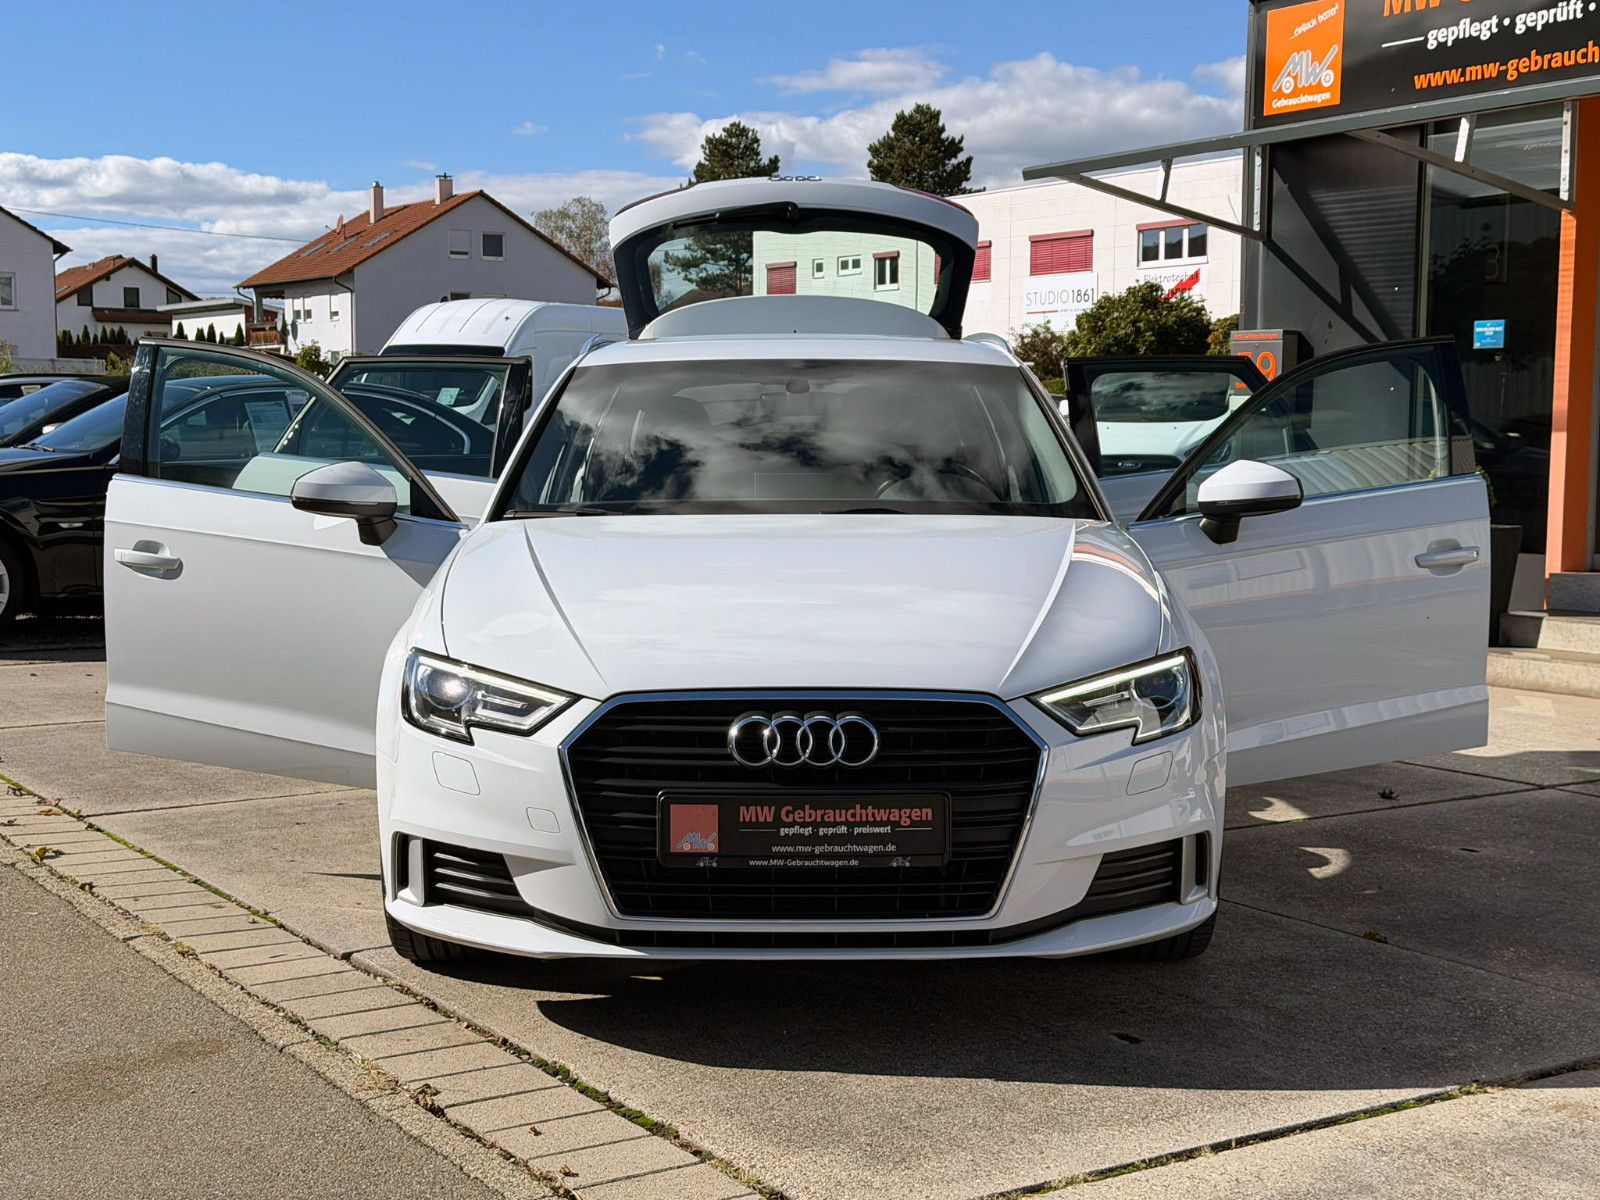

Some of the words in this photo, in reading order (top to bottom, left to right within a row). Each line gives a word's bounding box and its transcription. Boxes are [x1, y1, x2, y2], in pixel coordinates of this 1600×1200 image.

[1427, 15, 1499, 50] gepflegt
[1514, 1, 1584, 35] geprüft
[739, 805, 775, 823] MW
[780, 804, 933, 826] Gebrauchtwagen
[779, 826, 813, 837] gepflegt
[818, 825, 848, 836] geprüft
[853, 825, 892, 836] preiswert
[771, 843, 897, 854] www.mw-gebrauchtwagen.de
[749, 858, 860, 867] www.MW-Gebrauchtwagen.de
